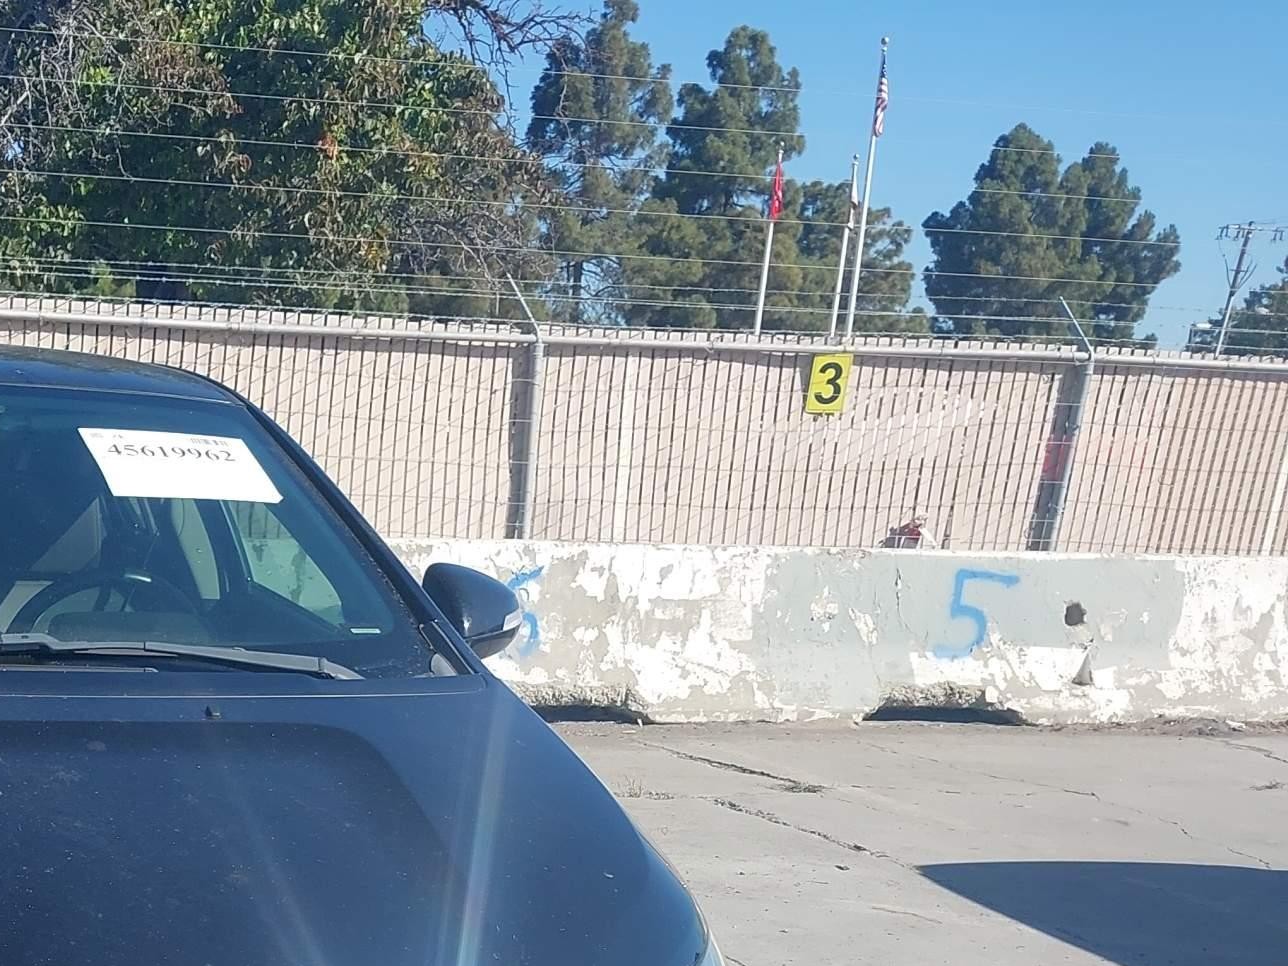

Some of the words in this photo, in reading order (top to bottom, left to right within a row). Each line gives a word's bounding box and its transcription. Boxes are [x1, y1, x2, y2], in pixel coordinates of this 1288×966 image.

[814, 362, 843, 405] 3
[107, 443, 236, 463] 45619962
[934, 568, 1020, 658] 5
